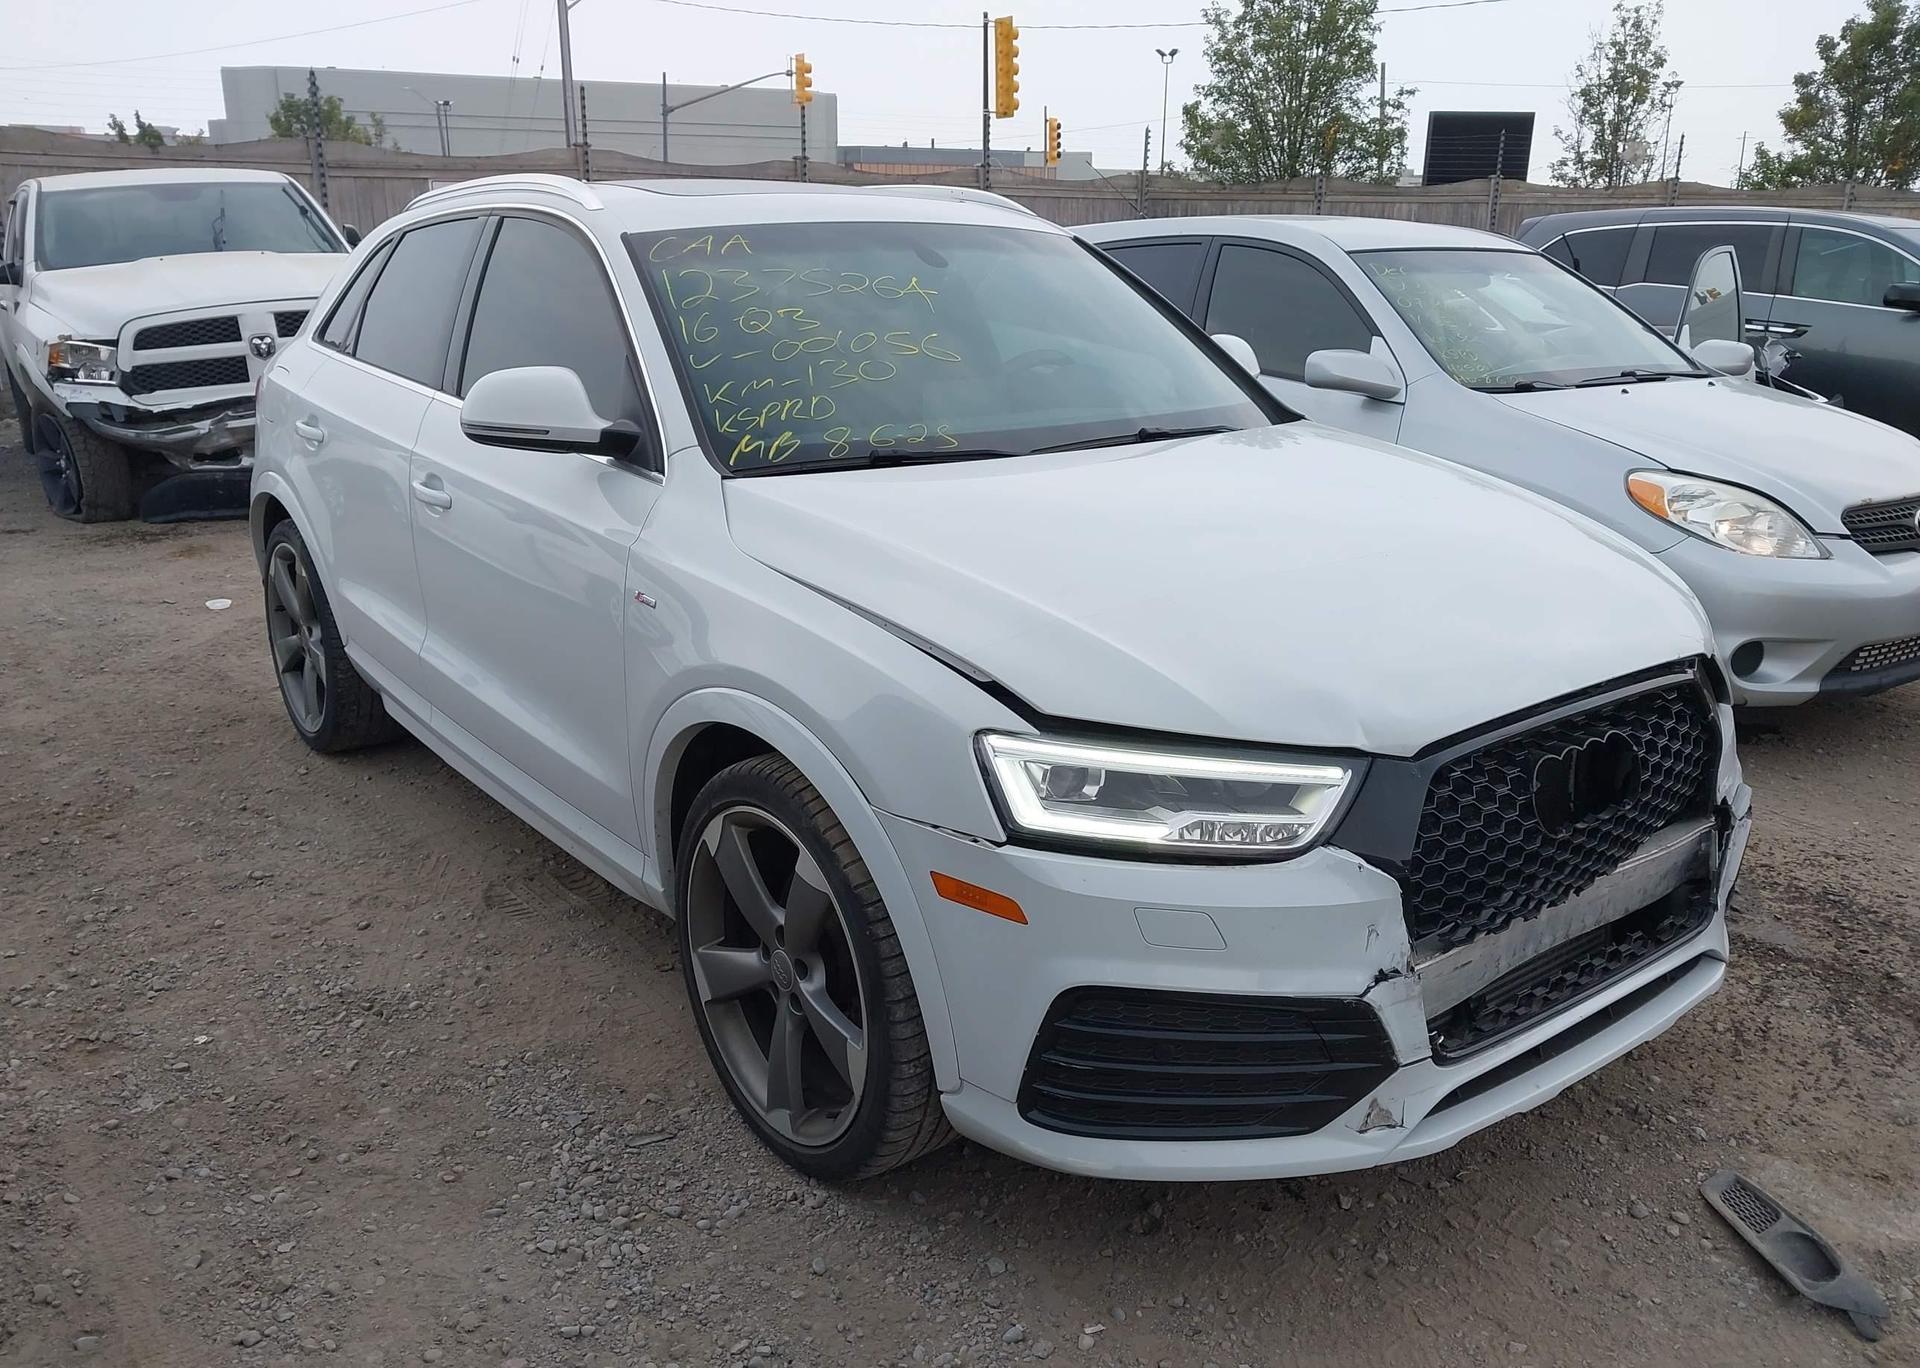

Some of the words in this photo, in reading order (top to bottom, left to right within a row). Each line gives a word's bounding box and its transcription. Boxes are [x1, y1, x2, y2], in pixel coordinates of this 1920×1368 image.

[649, 234, 753, 262] CAA
[678, 311, 718, 344] 16
[733, 307, 821, 336] Q3
